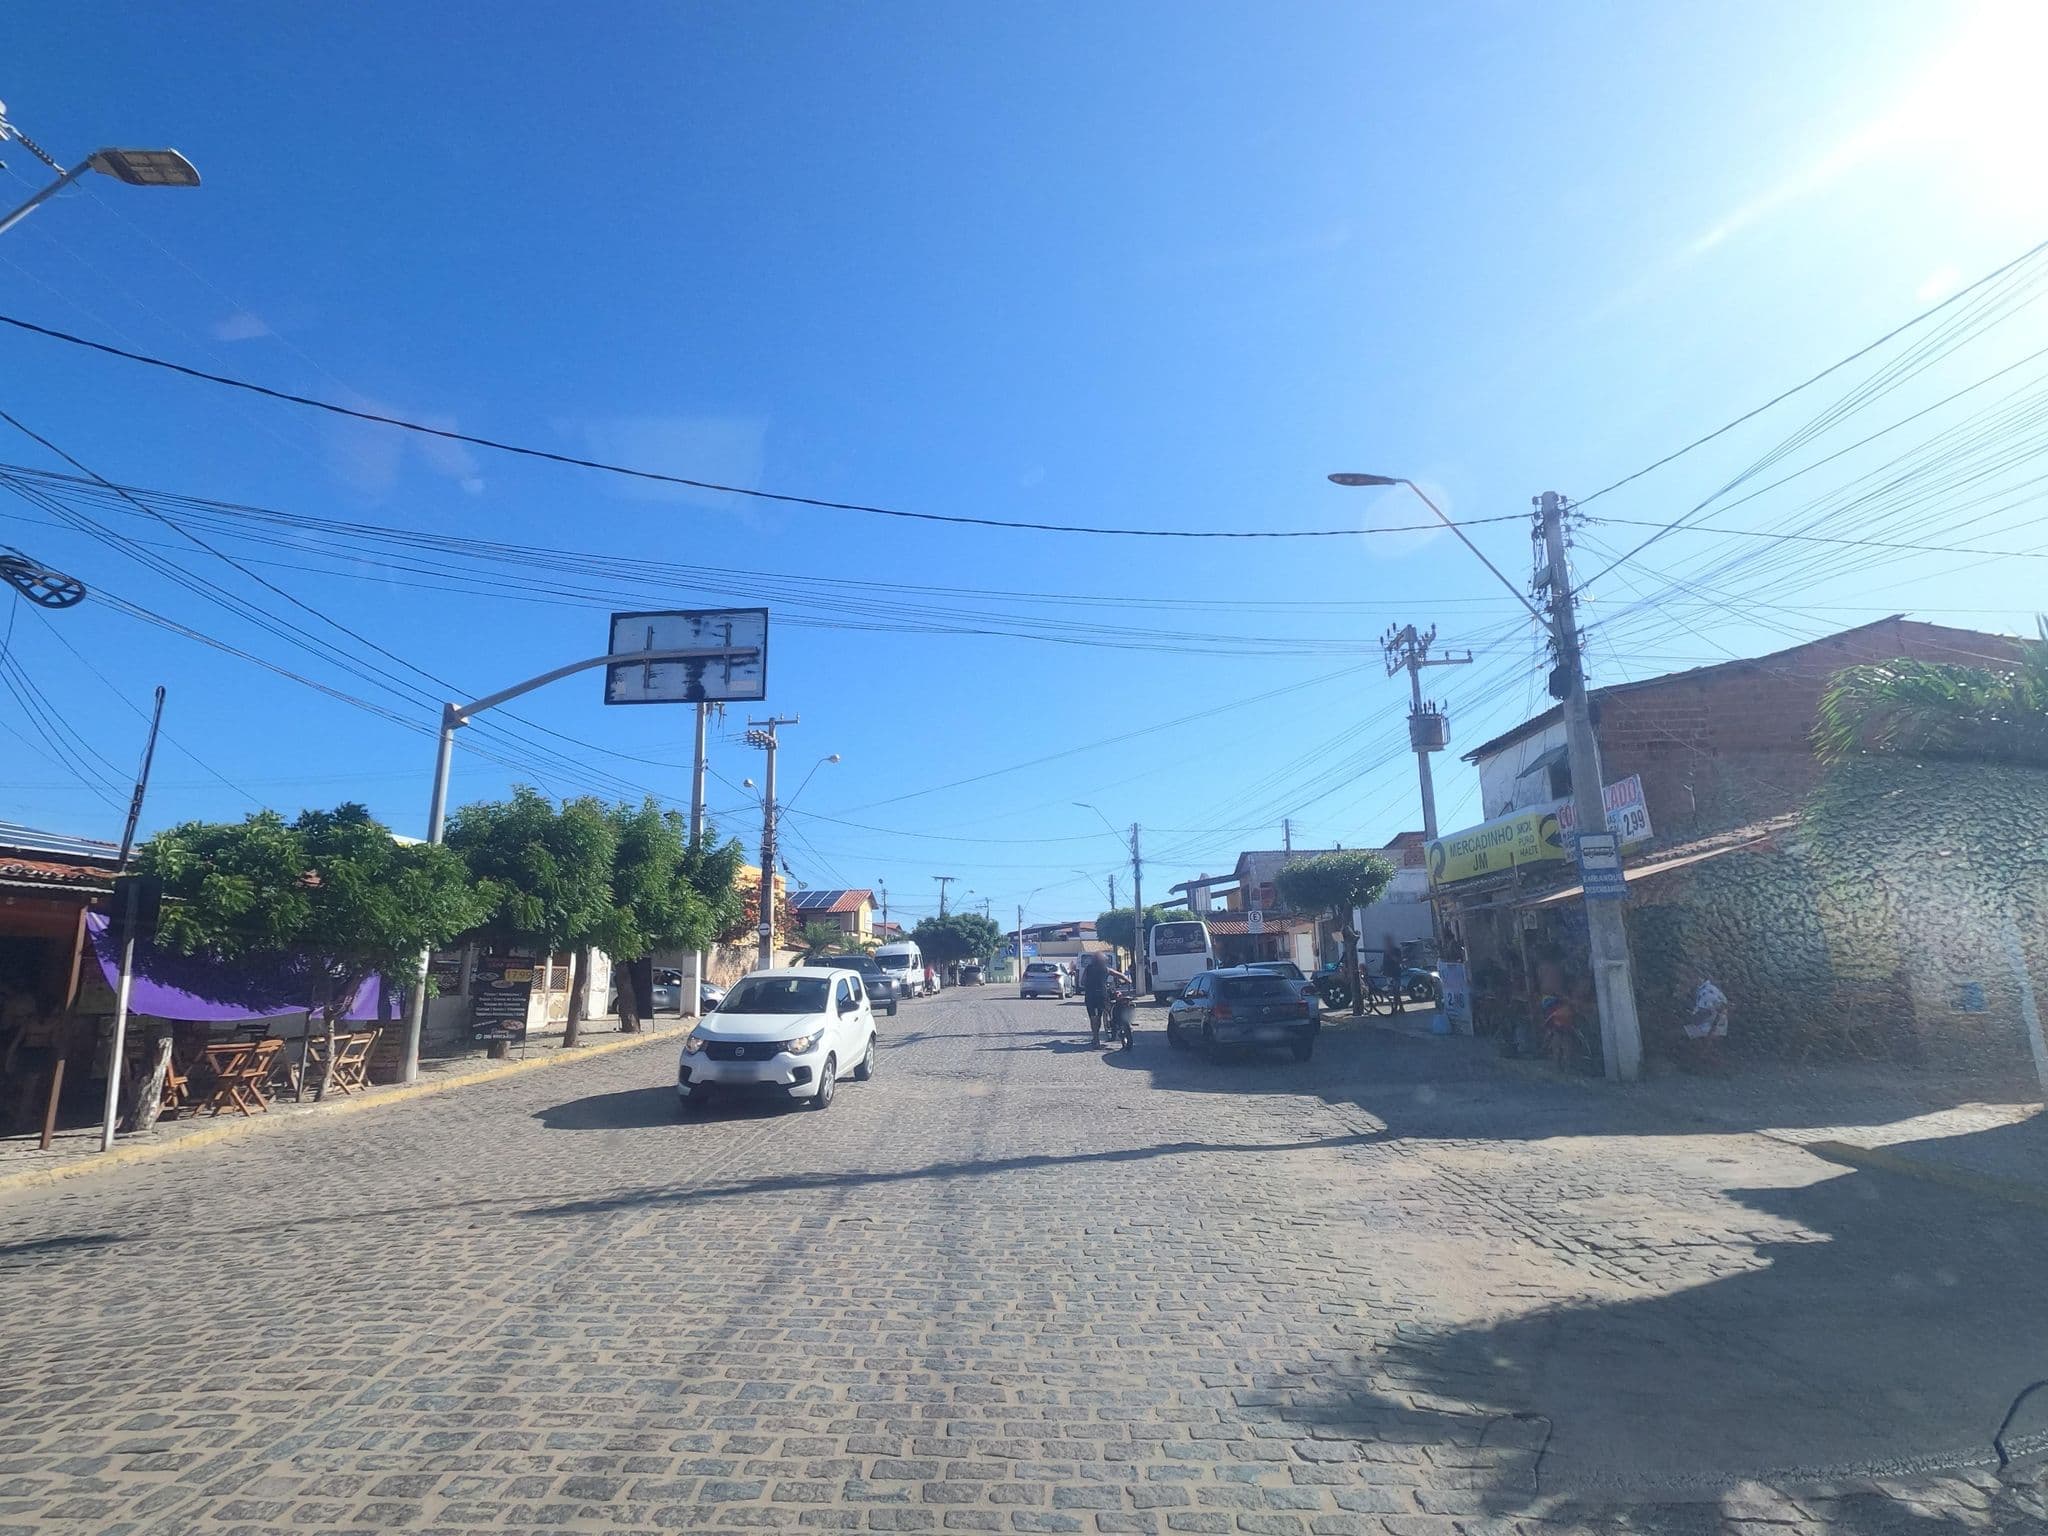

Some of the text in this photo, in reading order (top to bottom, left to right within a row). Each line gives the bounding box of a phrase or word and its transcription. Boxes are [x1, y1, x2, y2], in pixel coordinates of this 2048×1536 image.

[1449, 825, 1514, 858] MERCADINHO
[1623, 810, 1646, 843] 2,99
[1472, 851, 1489, 871] JM
